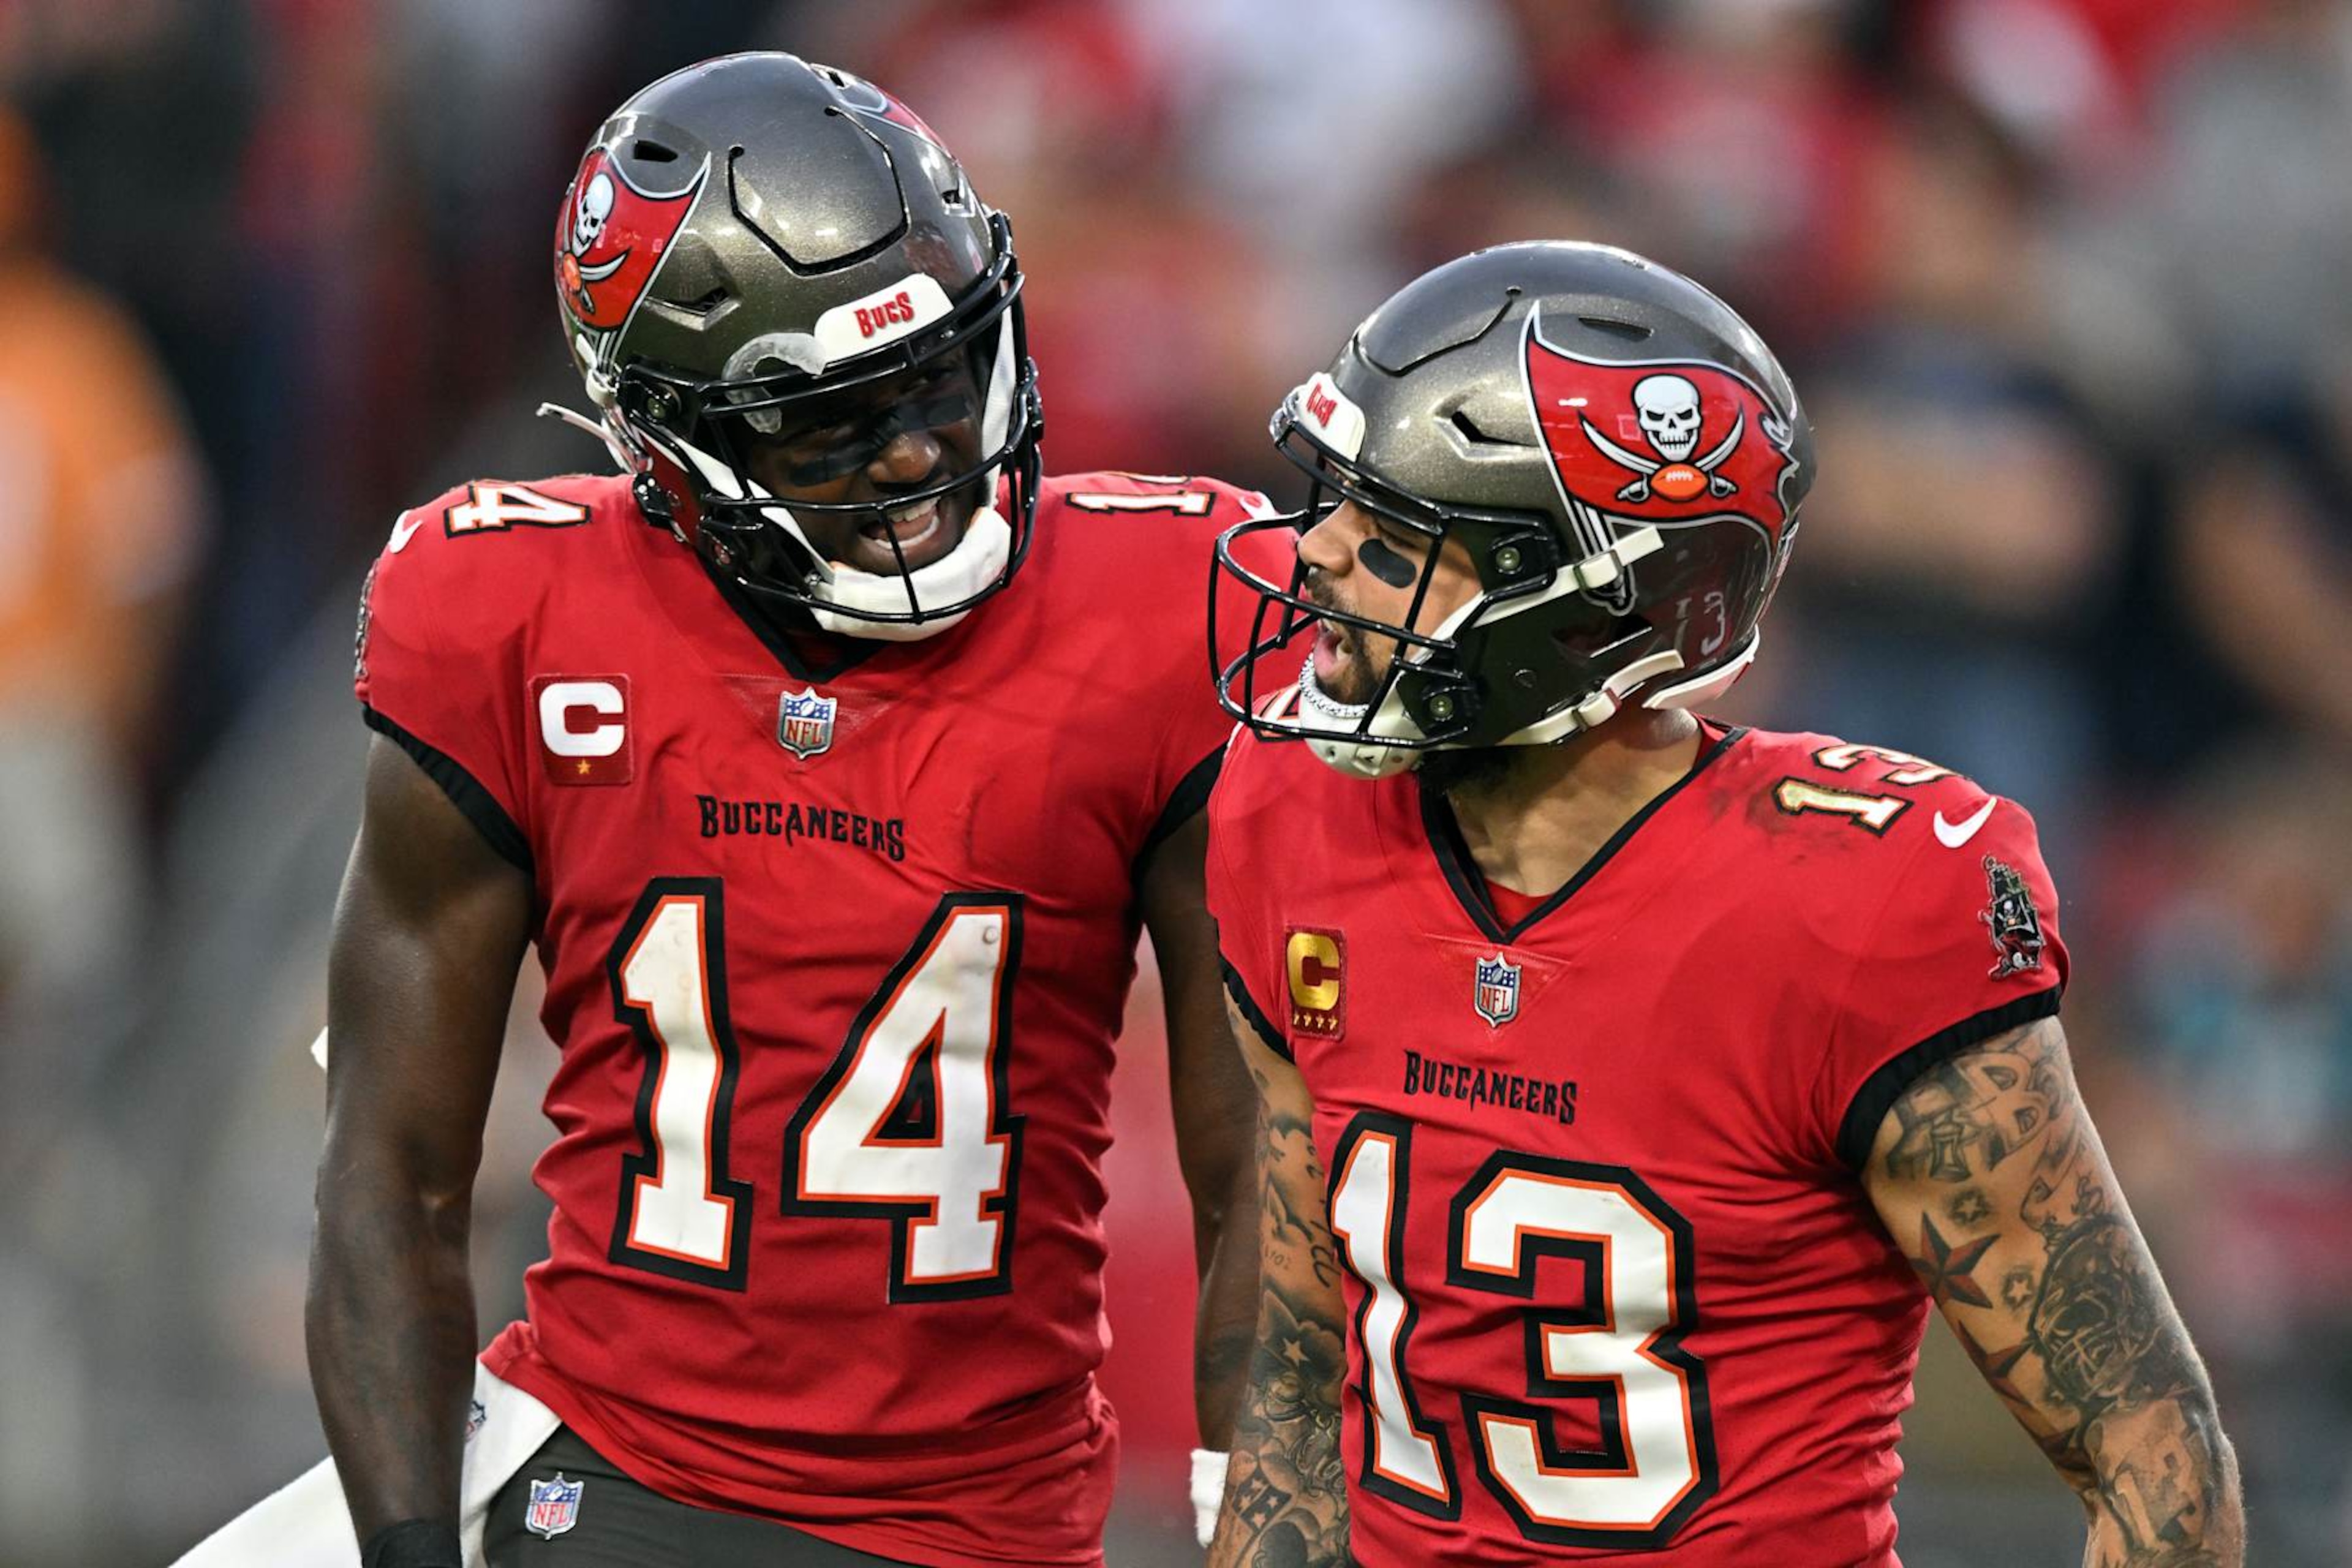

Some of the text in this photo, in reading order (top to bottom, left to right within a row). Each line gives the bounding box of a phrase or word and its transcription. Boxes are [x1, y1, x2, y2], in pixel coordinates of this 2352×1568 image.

[854, 291, 914, 337] BUCS
[539, 682, 625, 756] C
[786, 718, 824, 747] NFL
[696, 794, 905, 862] BUCCANEERS
[1287, 932, 1340, 1011] C
[1481, 986, 1510, 1014] NFL
[606, 876, 1027, 1305] 14
[1403, 1049, 1577, 1125] BUCCANEERS
[1326, 1110, 1720, 1549] 13
[534, 1504, 568, 1526] NFL
